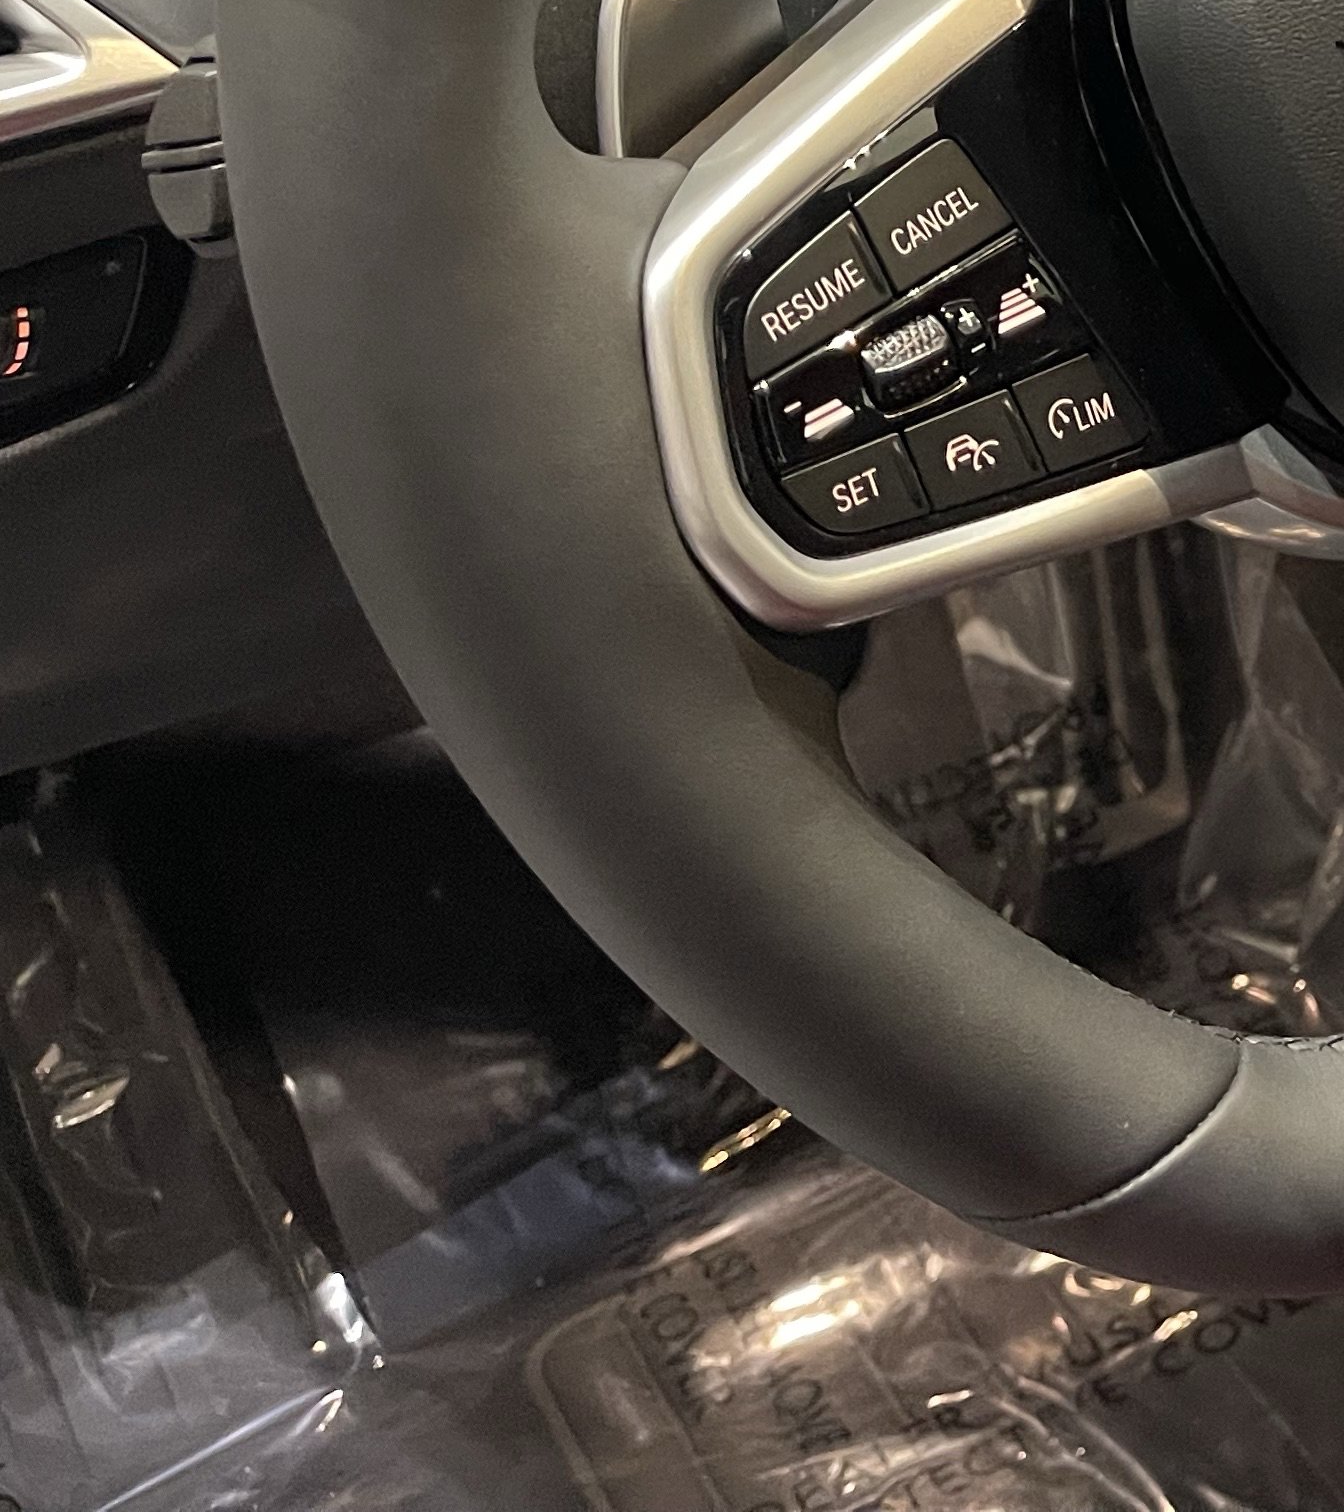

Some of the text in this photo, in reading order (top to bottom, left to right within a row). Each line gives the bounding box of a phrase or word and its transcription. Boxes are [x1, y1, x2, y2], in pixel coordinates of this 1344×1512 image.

[890, 186, 980, 256] CANCEL
[760, 258, 866, 344] RESUME
[1072, 392, 1116, 432] LIM
[832, 467, 880, 513] SET
